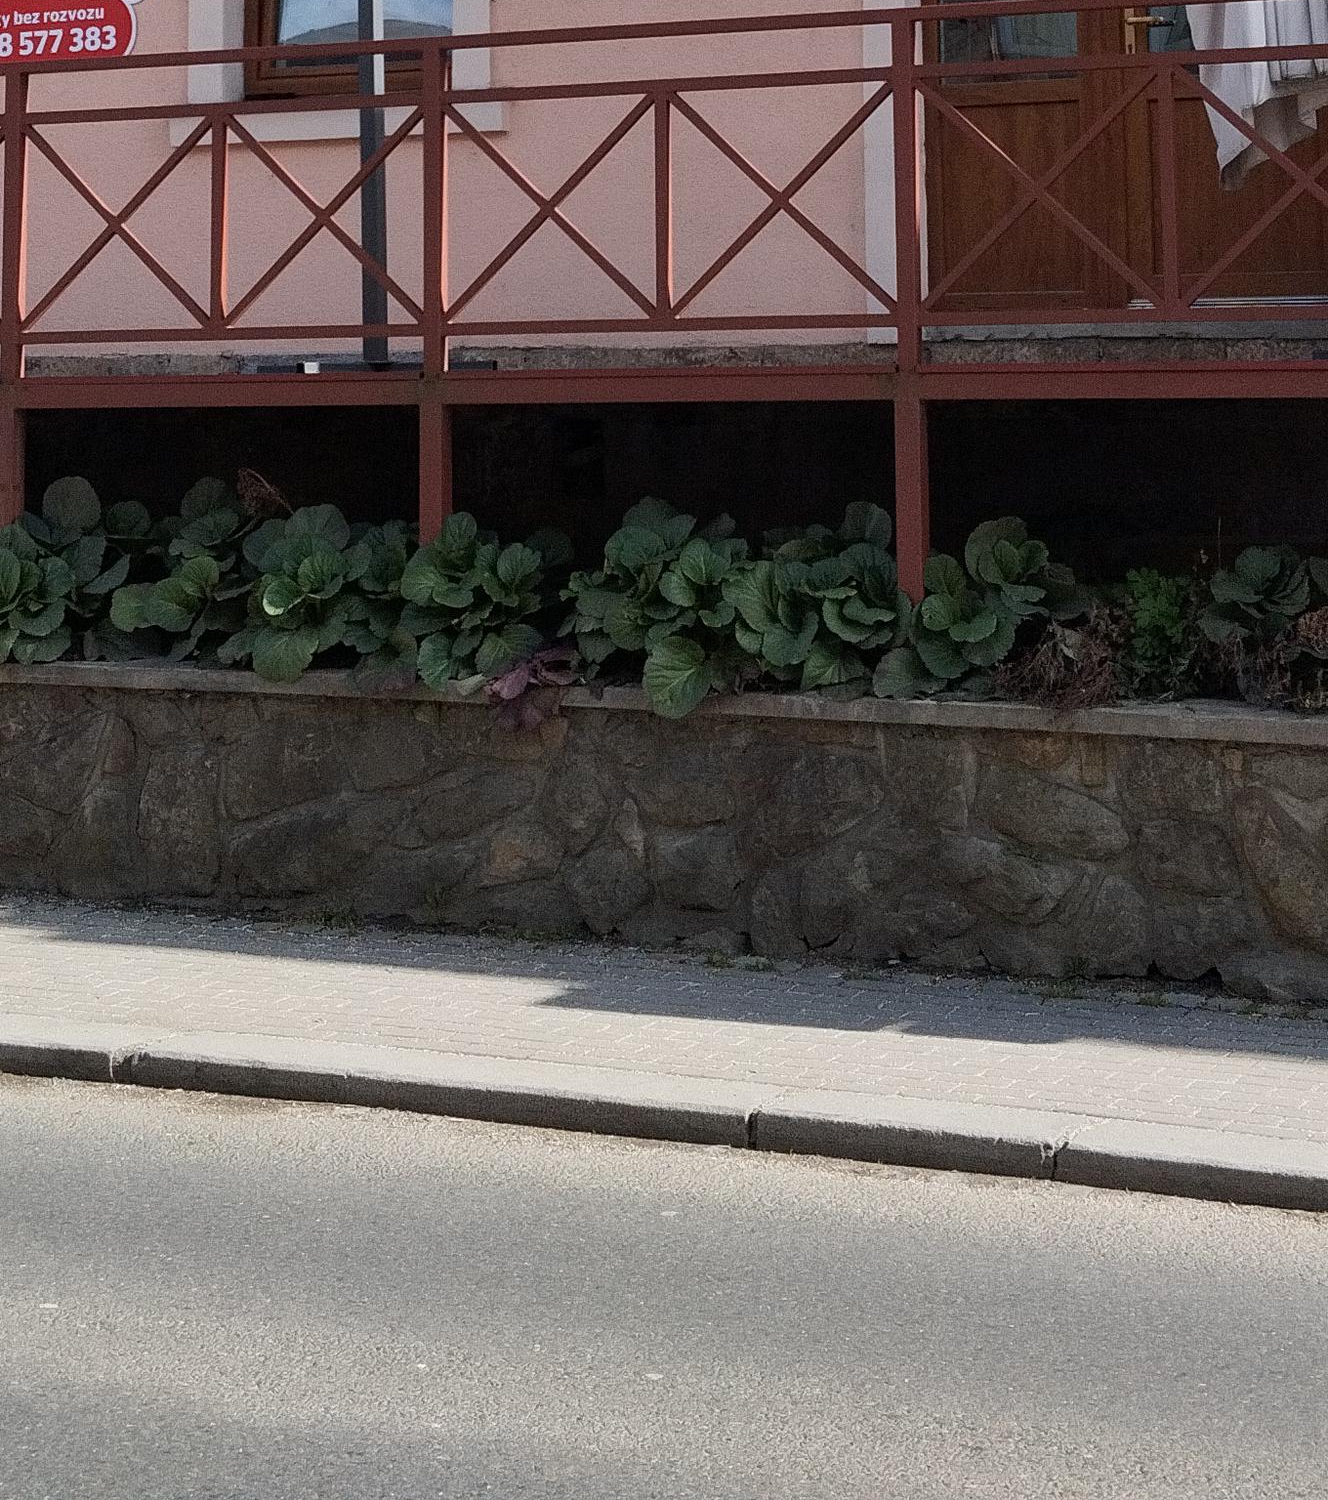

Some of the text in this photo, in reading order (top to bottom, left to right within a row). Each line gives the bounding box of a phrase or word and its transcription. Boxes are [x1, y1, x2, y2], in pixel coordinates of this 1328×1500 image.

[13, 11, 41, 26] bez
[43, 7, 105, 22] rozvozu
[19, 28, 64, 56] 577
[69, 25, 117, 52] 383
